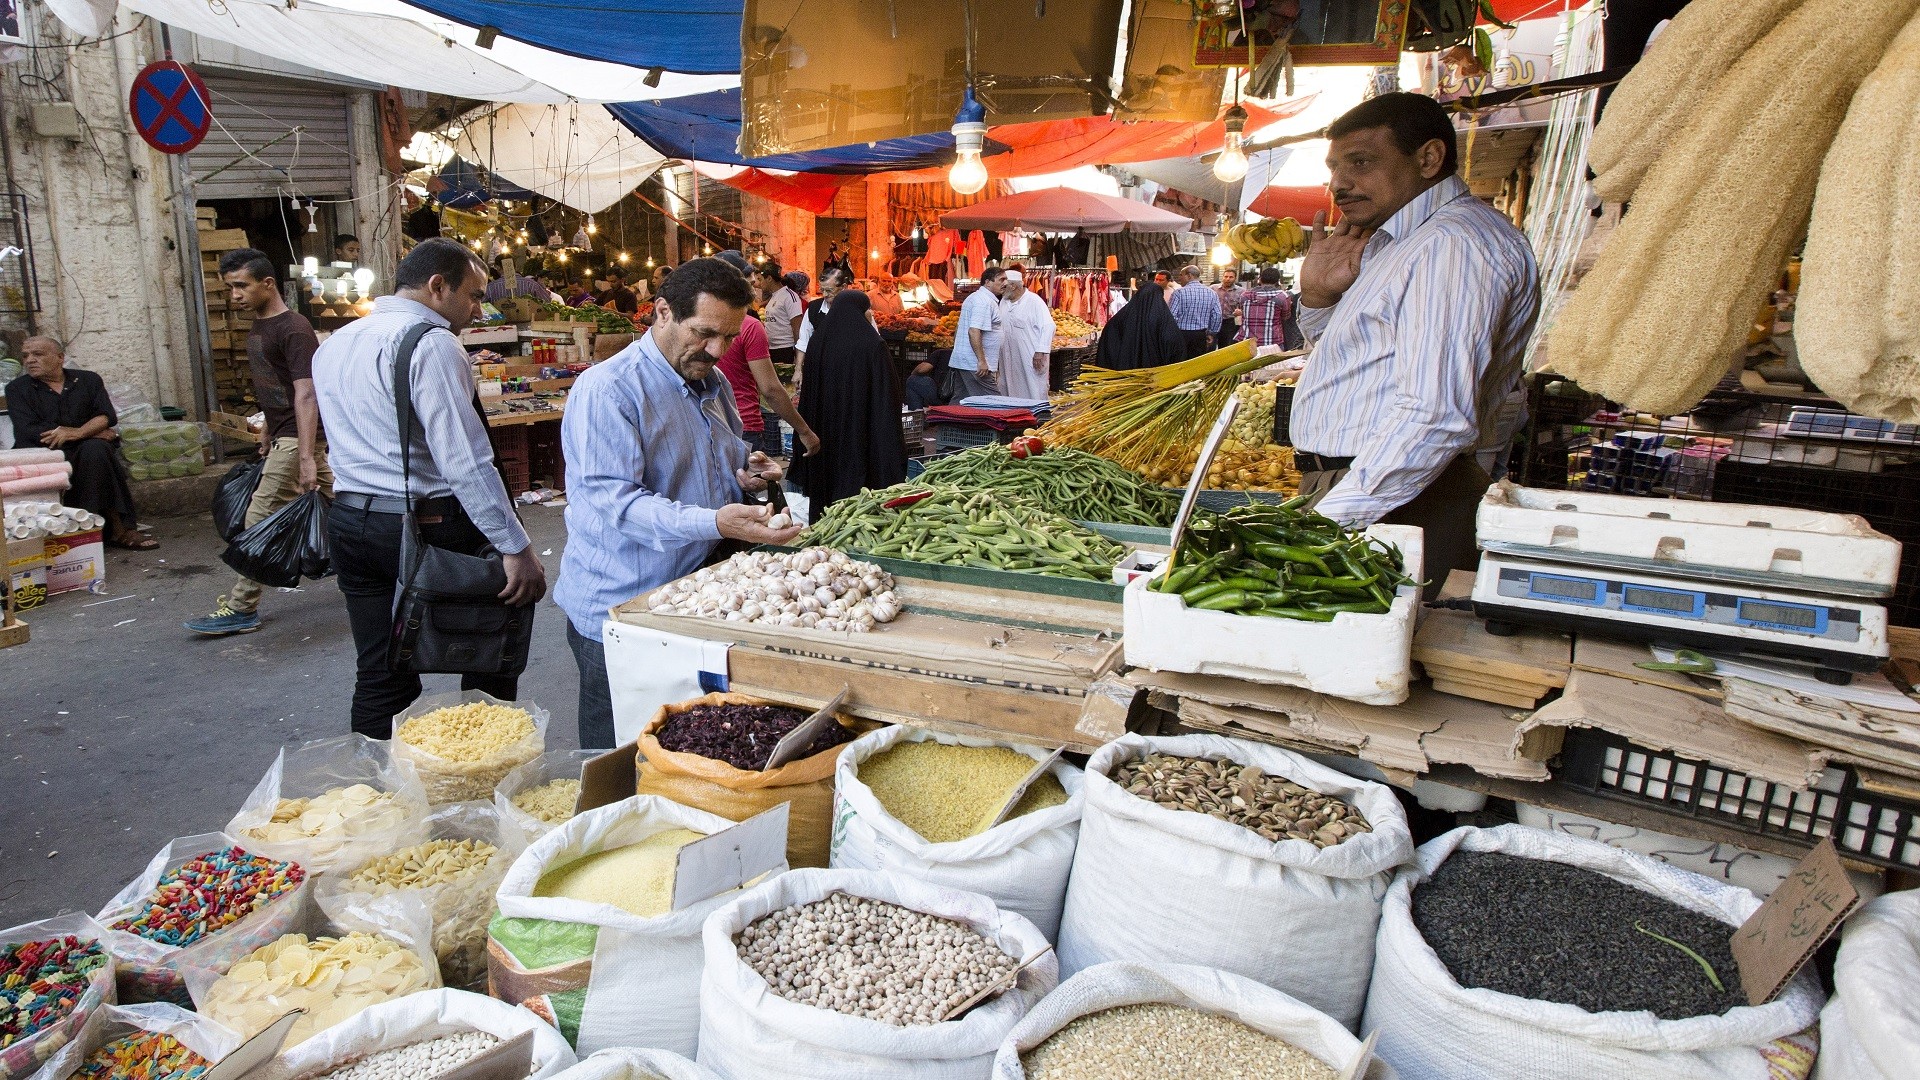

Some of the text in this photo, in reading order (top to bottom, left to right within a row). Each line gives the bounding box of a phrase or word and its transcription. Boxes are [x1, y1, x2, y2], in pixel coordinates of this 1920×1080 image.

[53, 560, 95, 579] FUTURE
[1656, 608, 1679, 616] PRICE
[1753, 621, 1778, 629] TOTAL
